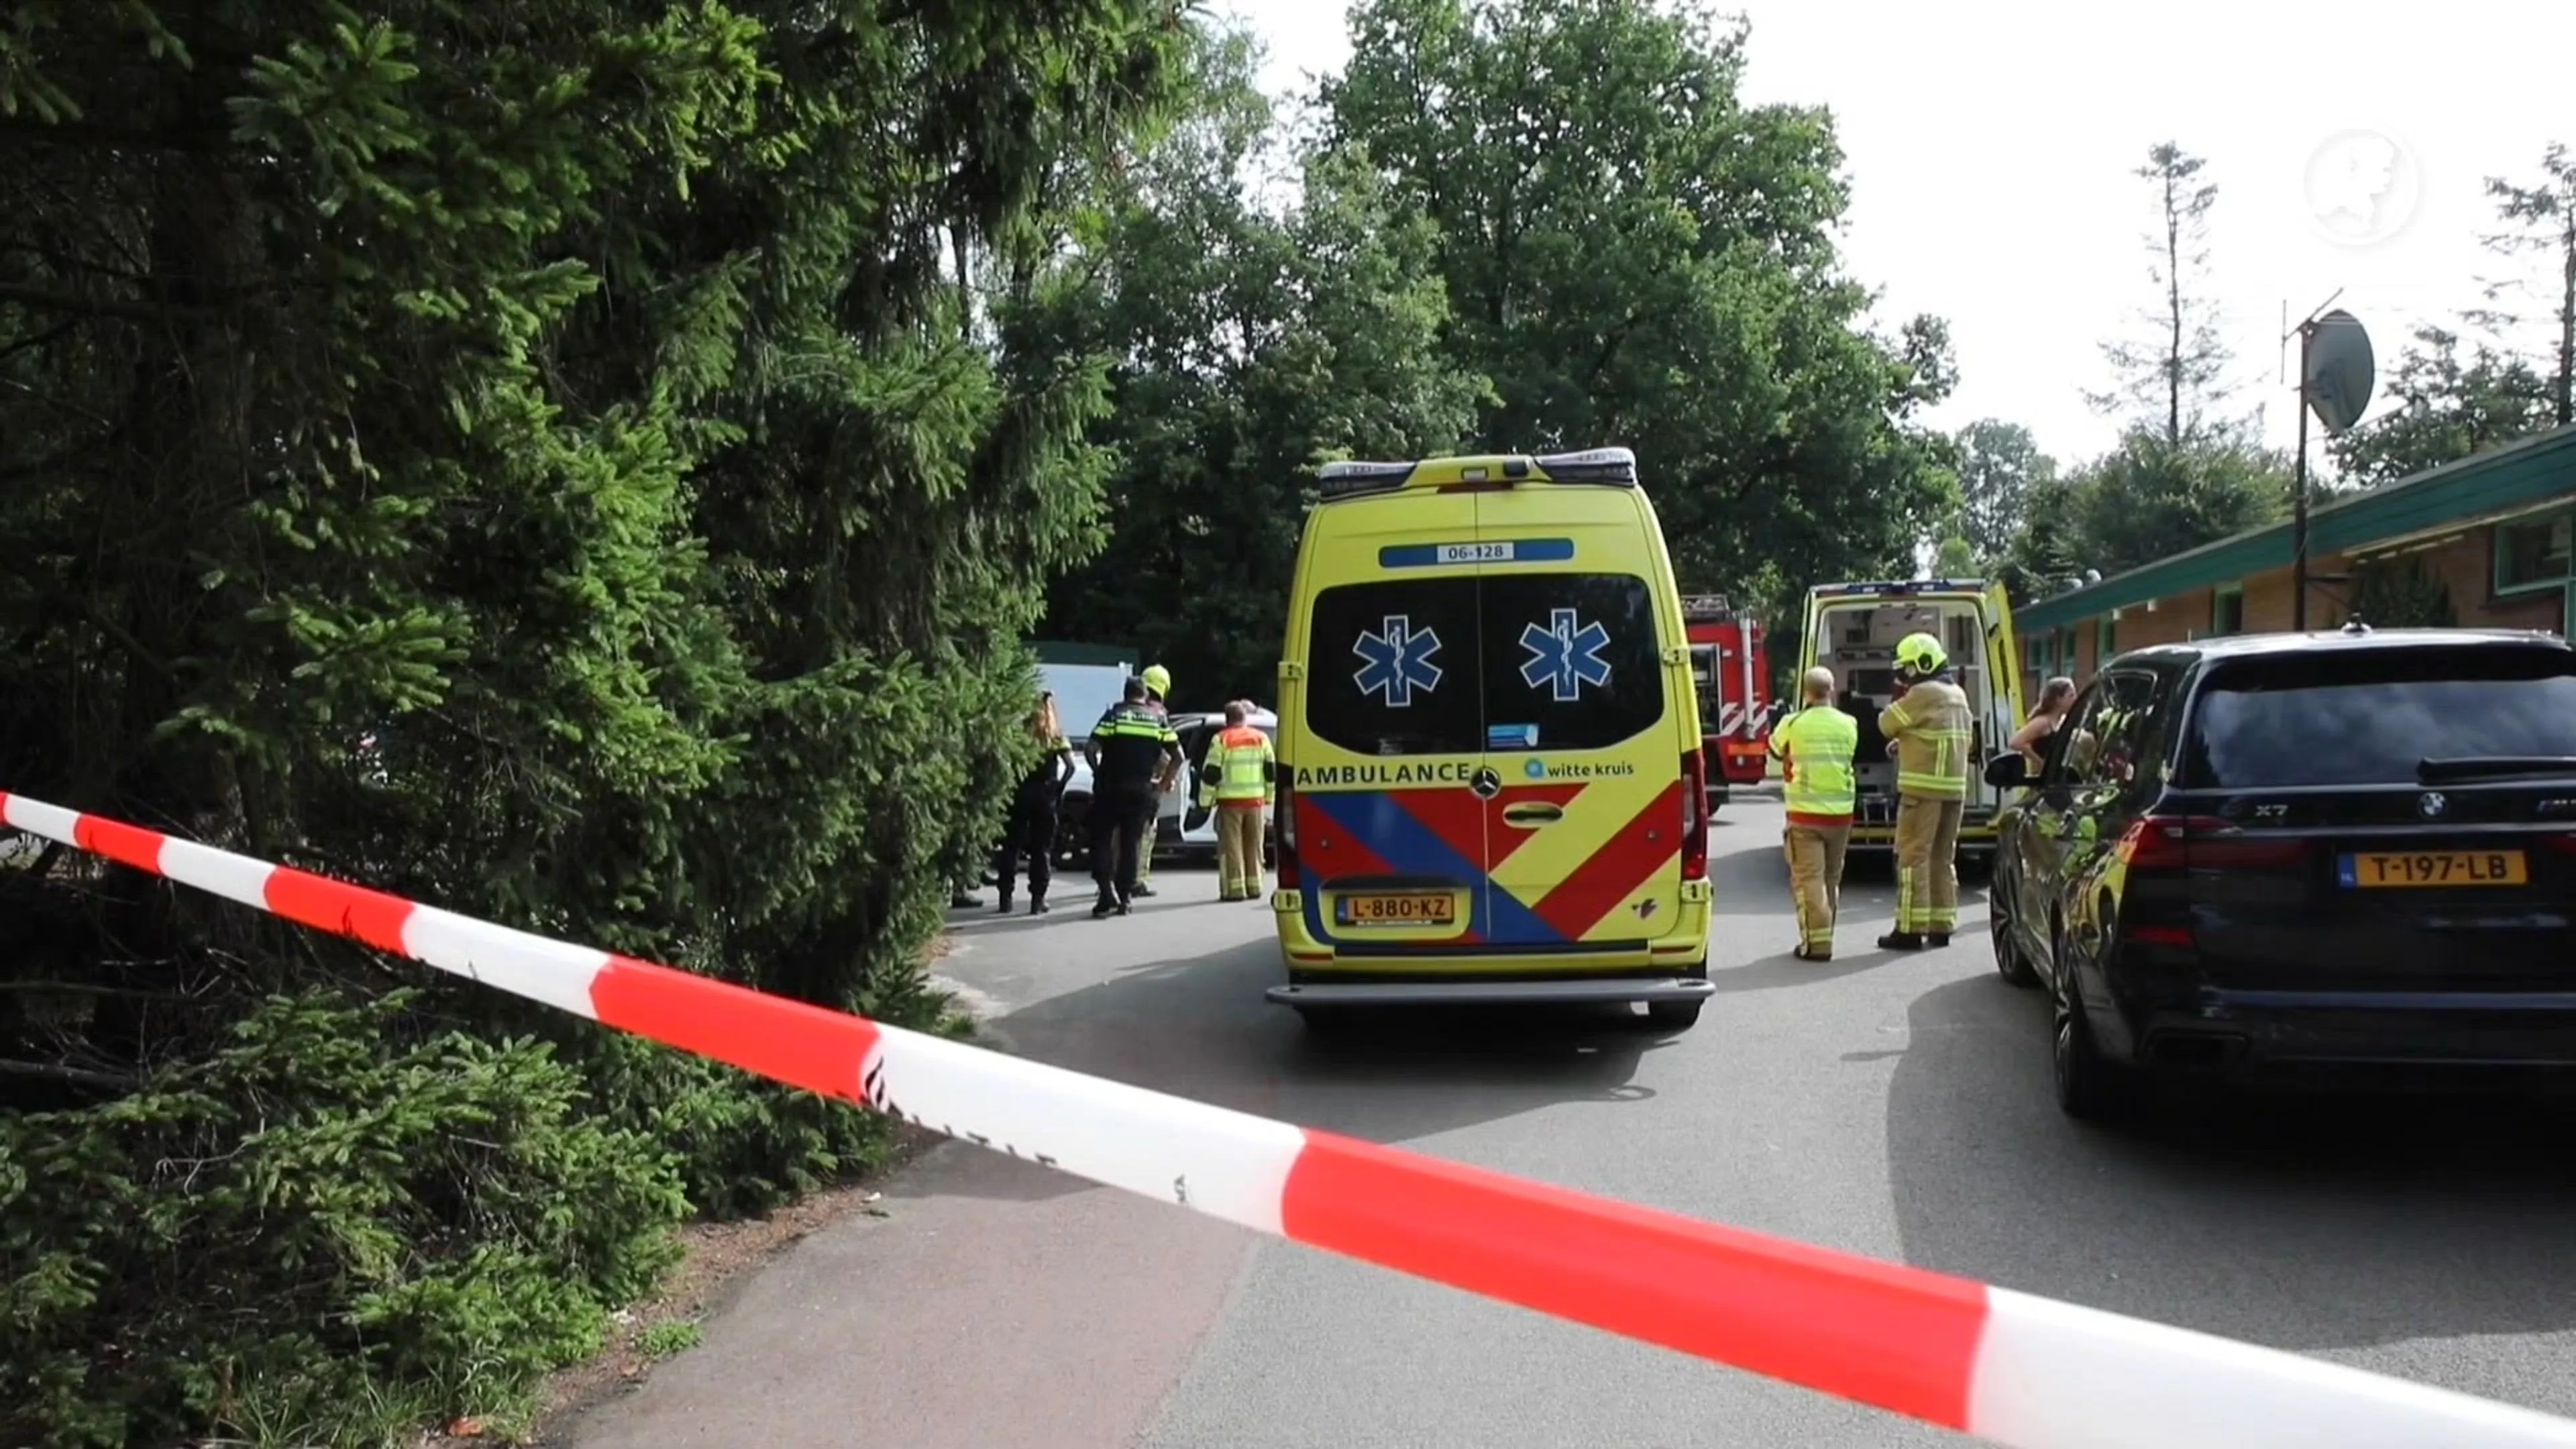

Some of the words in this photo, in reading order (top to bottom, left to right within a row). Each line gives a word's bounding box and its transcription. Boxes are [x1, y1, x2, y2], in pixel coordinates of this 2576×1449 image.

[1448, 545, 1503, 559] 06-128
[1296, 763, 1470, 785] AMBULANCE
[1547, 763, 1591, 777] witte
[1595, 760, 1634, 775] kruis
[2255, 805, 2288, 816] X7
[2370, 855, 2508, 881] T-197-LB
[1353, 899, 1446, 917] L-880-KZ
